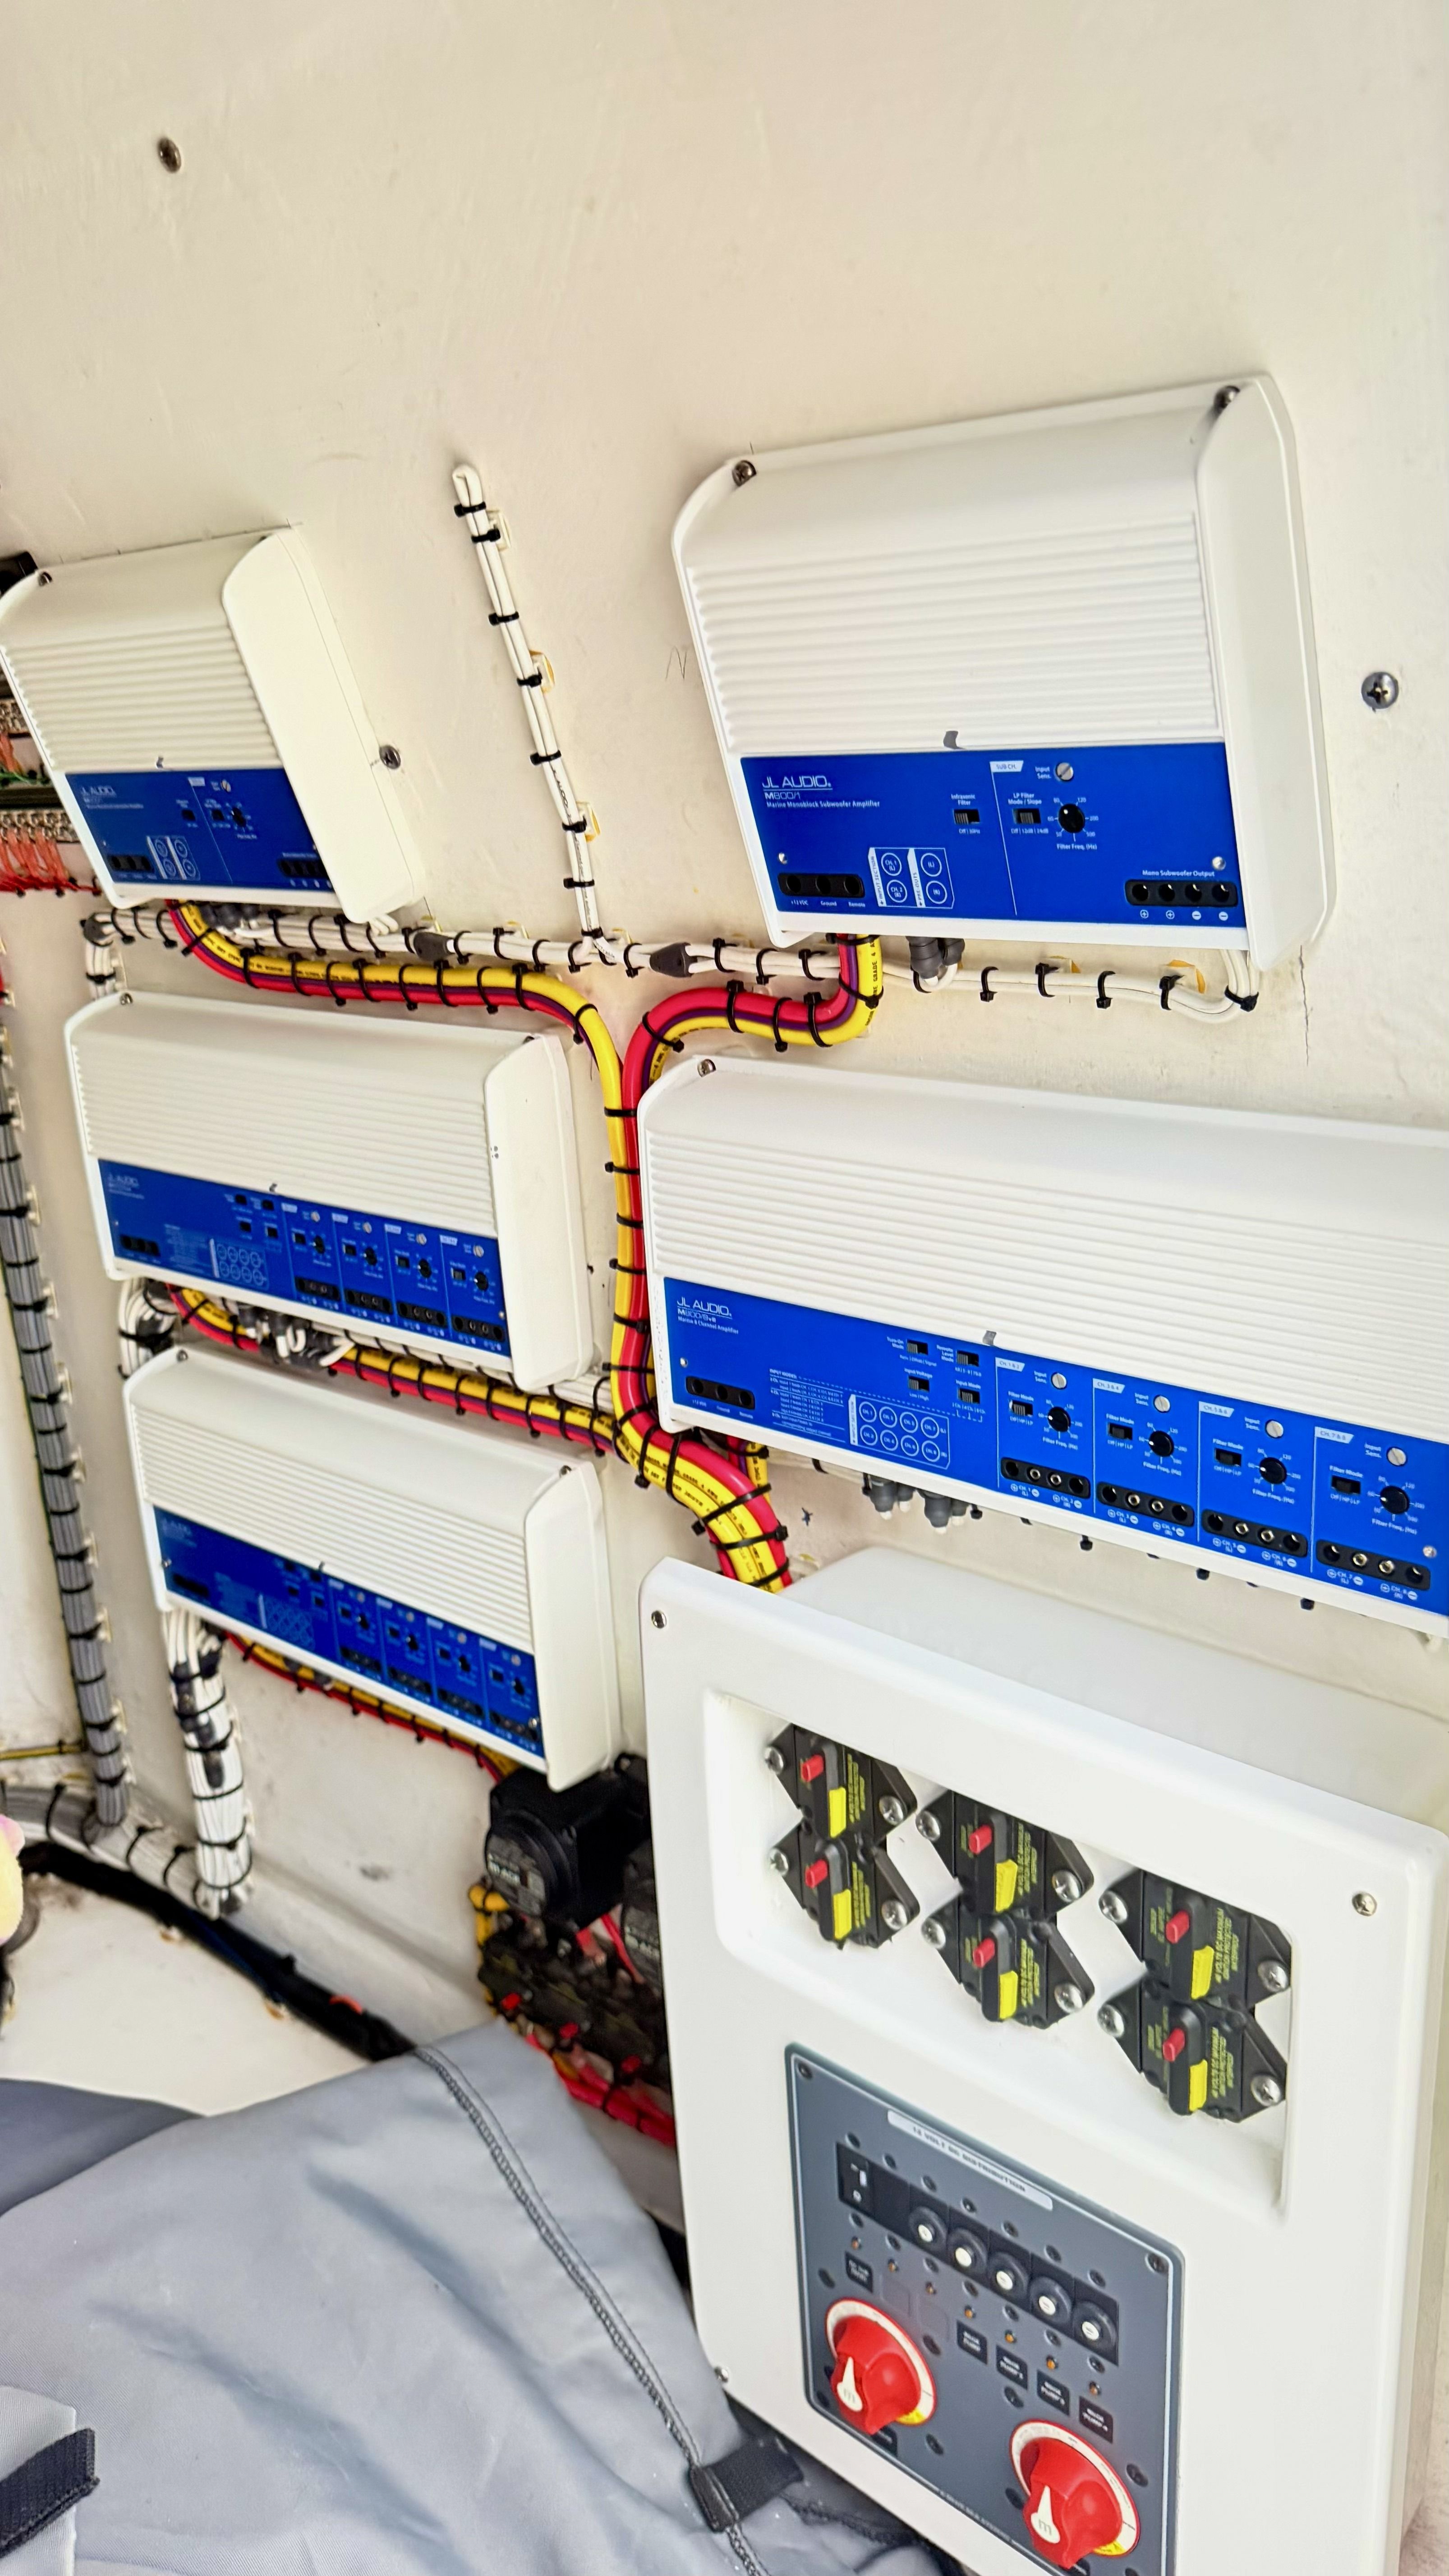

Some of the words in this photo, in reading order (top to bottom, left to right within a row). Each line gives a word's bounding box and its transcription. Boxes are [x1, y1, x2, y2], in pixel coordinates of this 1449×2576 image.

[762, 776, 779, 788] JL
[852, 800, 880, 808] Amplifier
[676, 1297, 690, 1308] JL
